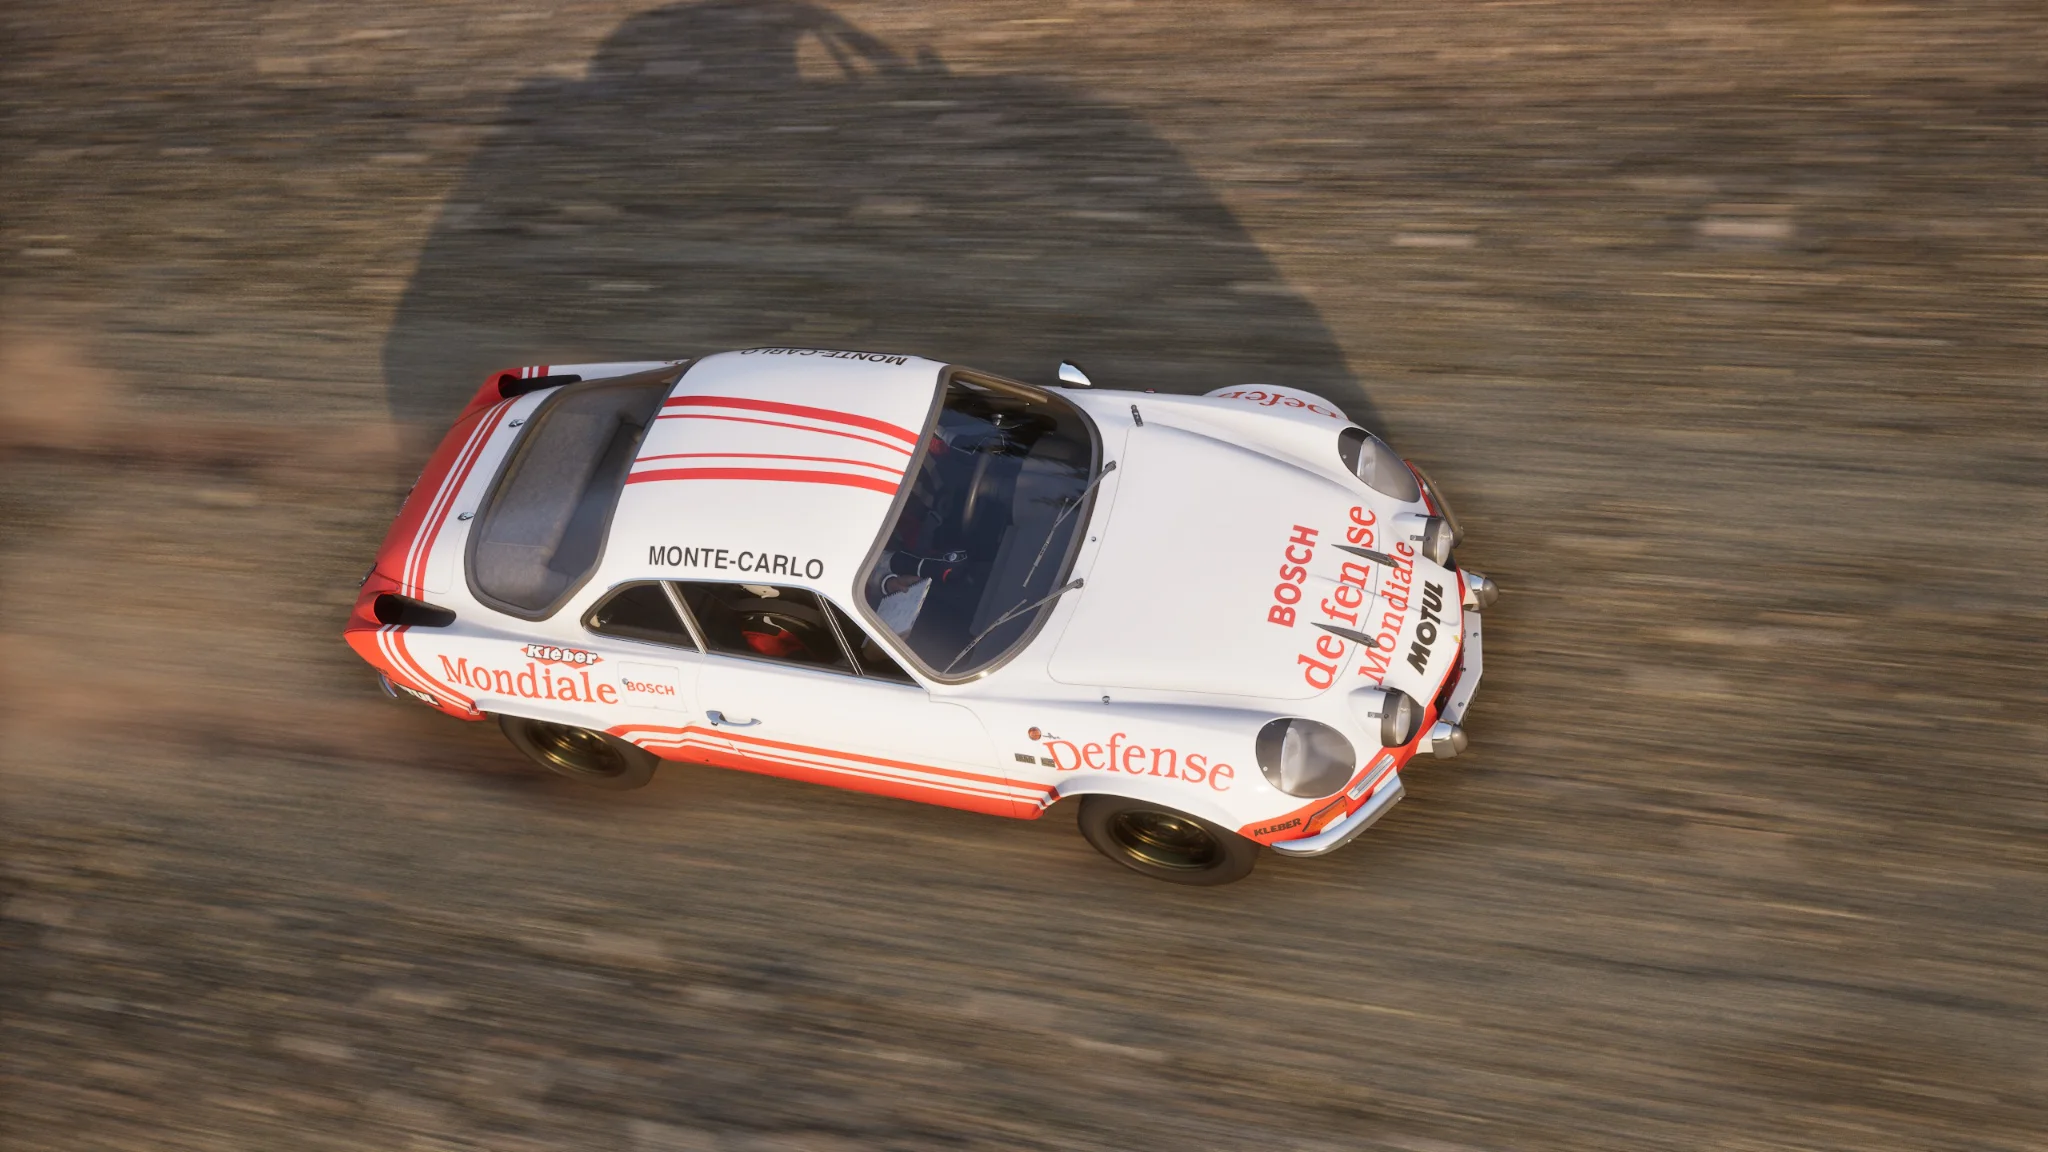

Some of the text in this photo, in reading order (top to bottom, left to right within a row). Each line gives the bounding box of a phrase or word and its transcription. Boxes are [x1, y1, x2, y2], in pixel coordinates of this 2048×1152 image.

[649, 545, 824, 580] MONTE-CARLO
[1267, 524, 1319, 628] BOSCH
[1358, 541, 1415, 686] Mondiale
[1406, 580, 1444, 676] MOTUL
[438, 654, 619, 704] Mondiale
[626, 680, 676, 696] BOSCH
[1043, 732, 1235, 792] Defense
[1253, 817, 1302, 837] KLEBER
